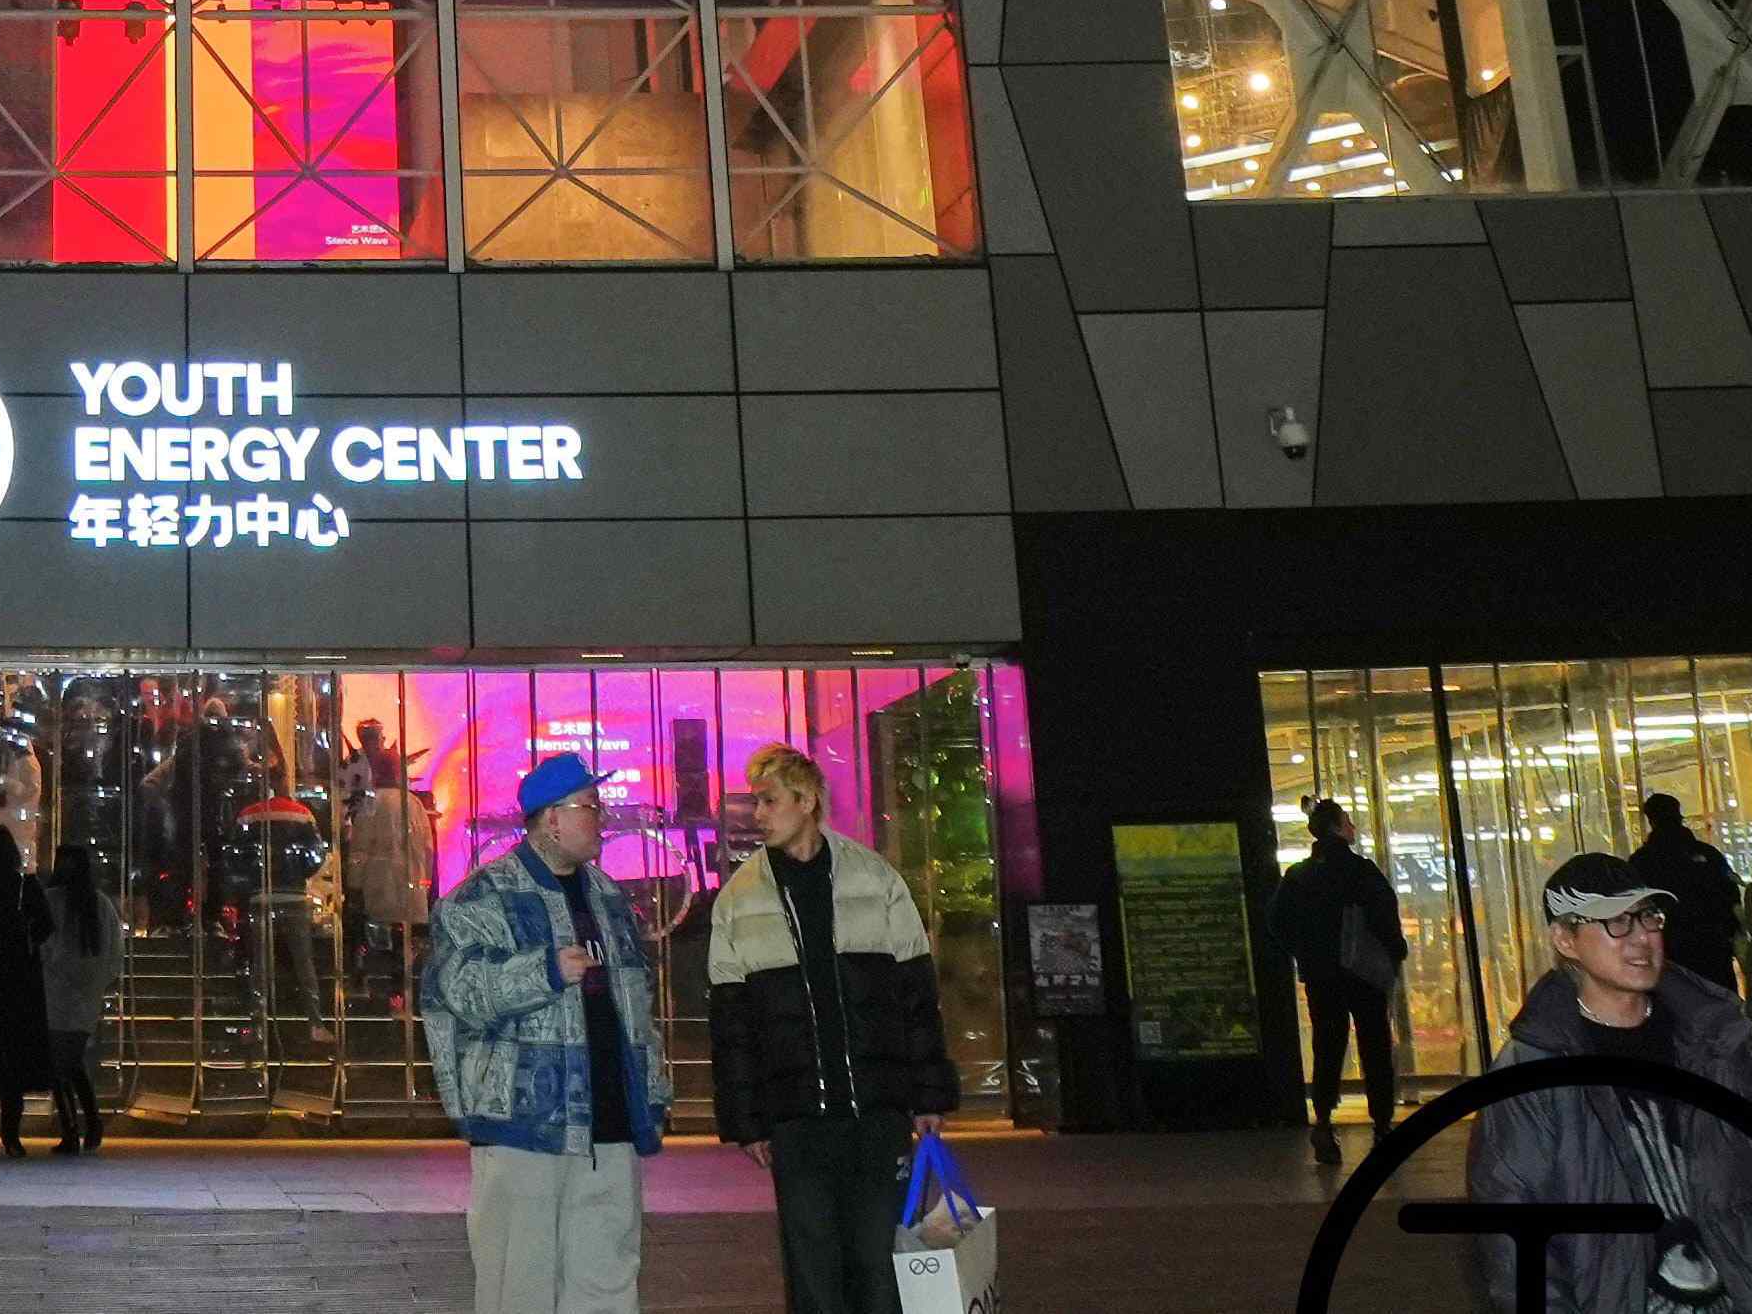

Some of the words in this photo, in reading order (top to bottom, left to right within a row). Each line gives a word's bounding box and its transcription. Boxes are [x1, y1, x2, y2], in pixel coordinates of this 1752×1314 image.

[70, 361, 293, 417] YOUTH
[75, 425, 316, 483] ENERGY
[332, 425, 584, 482] CENTER
[69, 495, 350, 549] 年轻力中心
